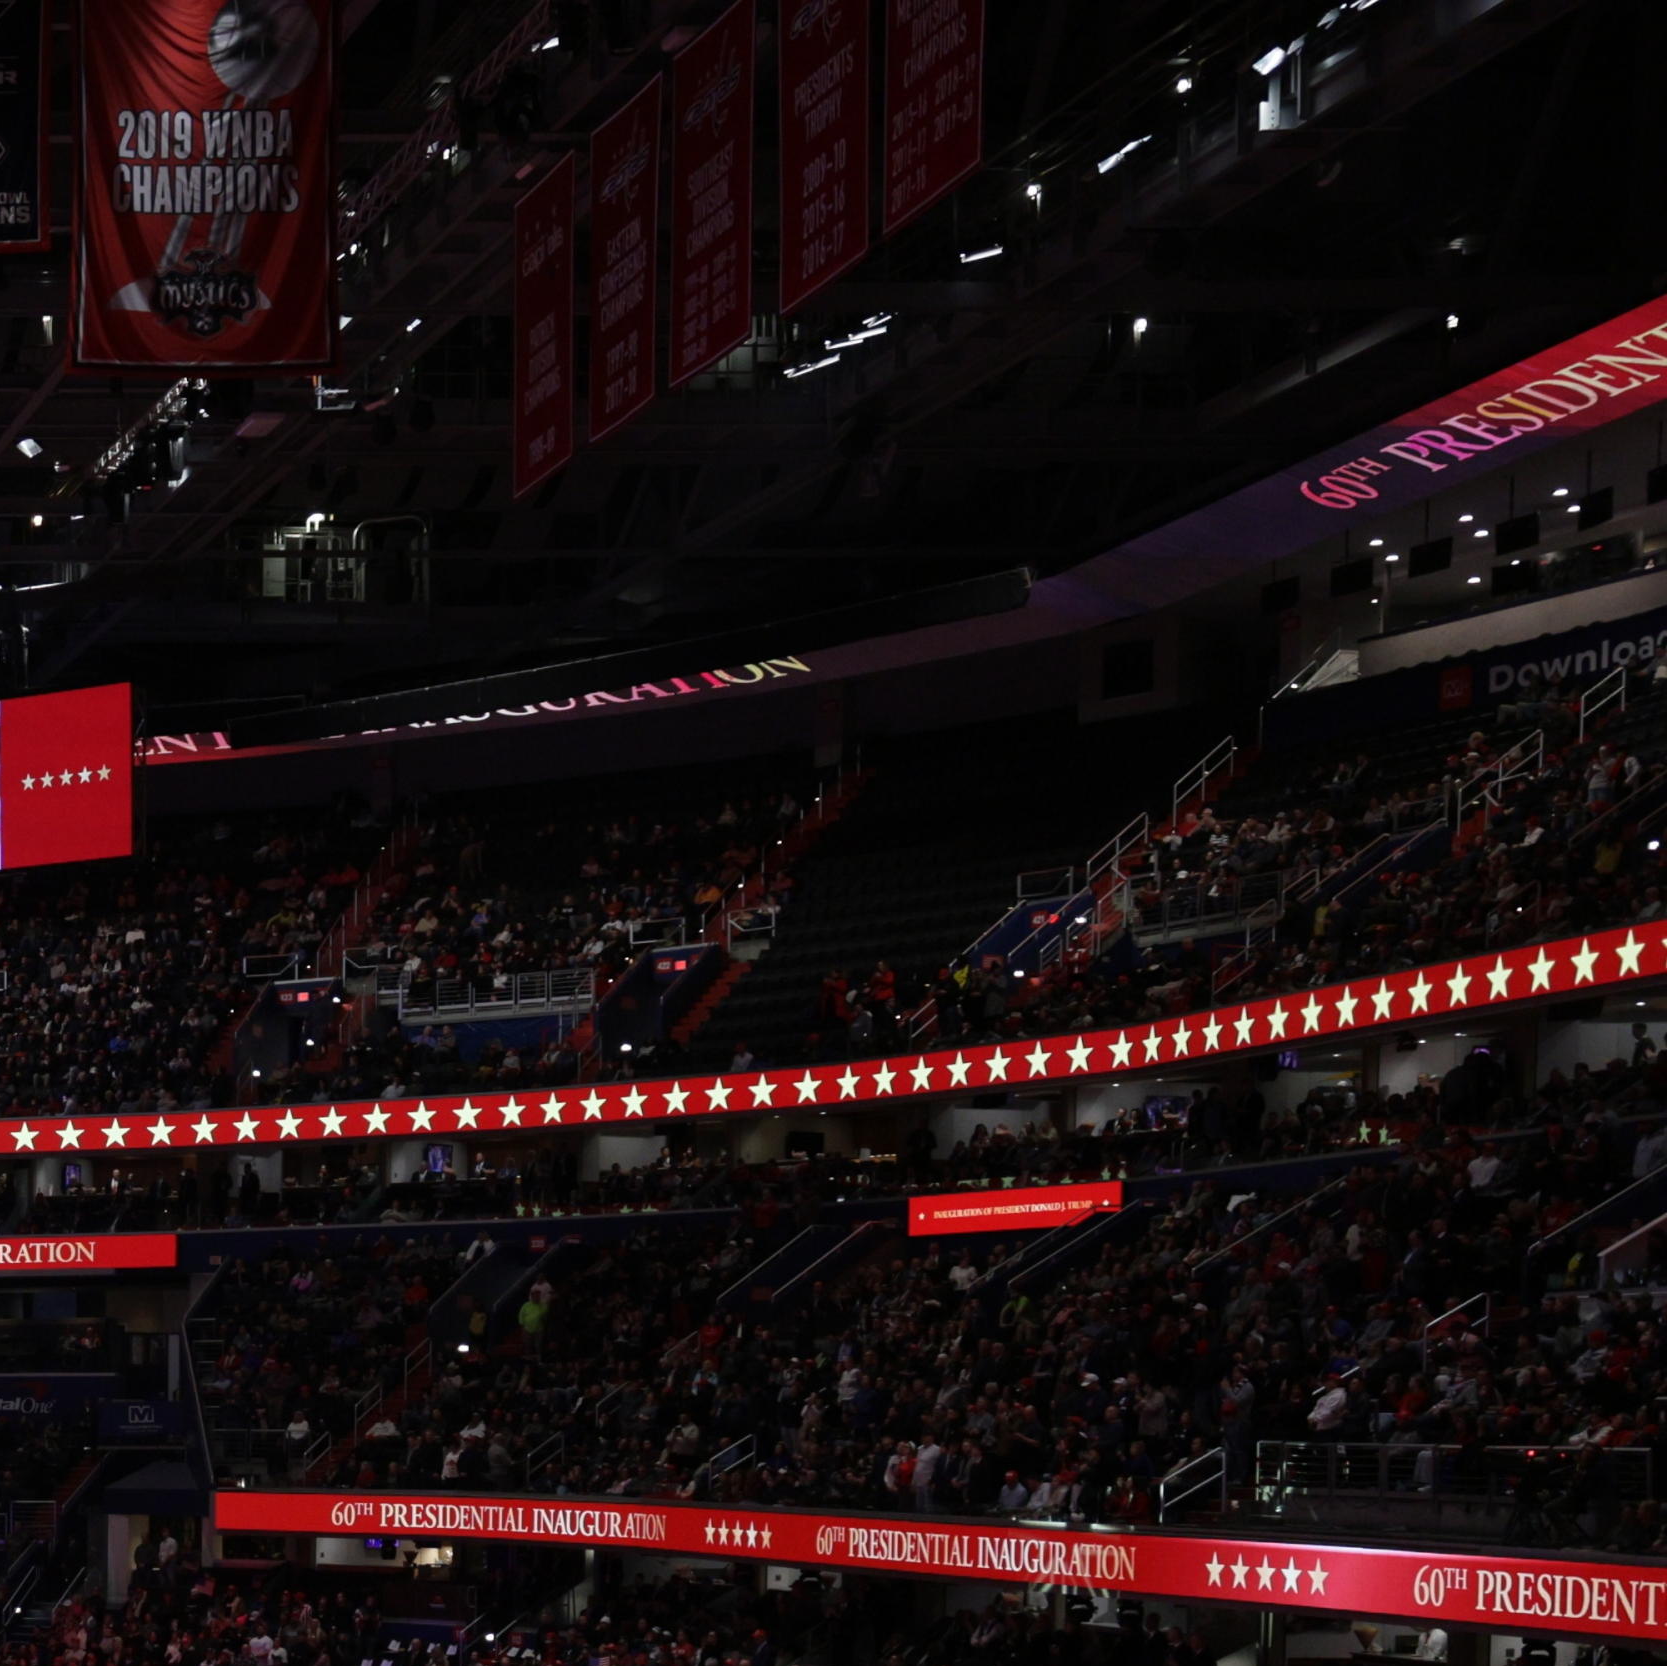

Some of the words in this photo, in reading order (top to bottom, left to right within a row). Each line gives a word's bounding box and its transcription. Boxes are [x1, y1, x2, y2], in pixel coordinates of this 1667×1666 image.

[117, 109, 194, 160] 2019
[202, 108, 295, 160] WNBA
[113, 163, 300, 215] CHAMPIONS
[1300, 456, 1393, 510] 60TH
[983, 1207, 993, 1216] OF
[993, 1204, 1031, 1215] PRESIDENT
[1031, 1202, 1060, 1213] DONALD
[1067, 1199, 1093, 1210] TRUMP
[331, 1501, 374, 1527] 60TH
[379, 1502, 528, 1534] PRESIDENTIAL
[532, 1508, 667, 1542] INAUGURATION
[816, 1523, 846, 1556] 60TH
[848, 1526, 974, 1569] PRESIDENTIAL
[977, 1534, 1137, 1582] INAUGURATION
[1413, 1564, 1468, 1607] 60TH
